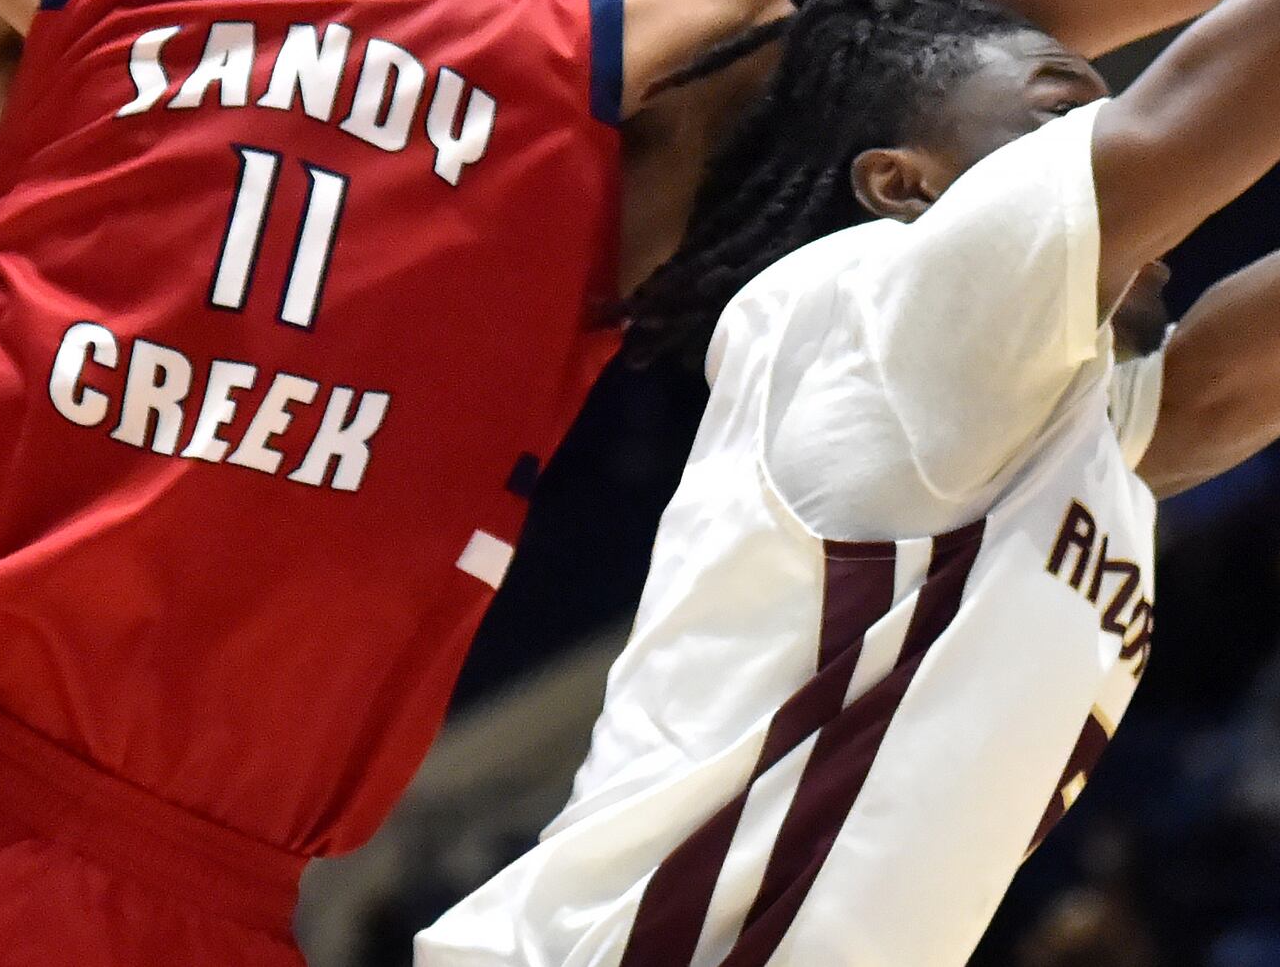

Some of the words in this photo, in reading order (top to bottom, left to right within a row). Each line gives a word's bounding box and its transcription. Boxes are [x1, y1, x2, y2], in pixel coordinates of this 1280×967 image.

[116, 20, 497, 187] SANDY
[209, 145, 349, 330] 11
[48, 321, 391, 492] CREEK
